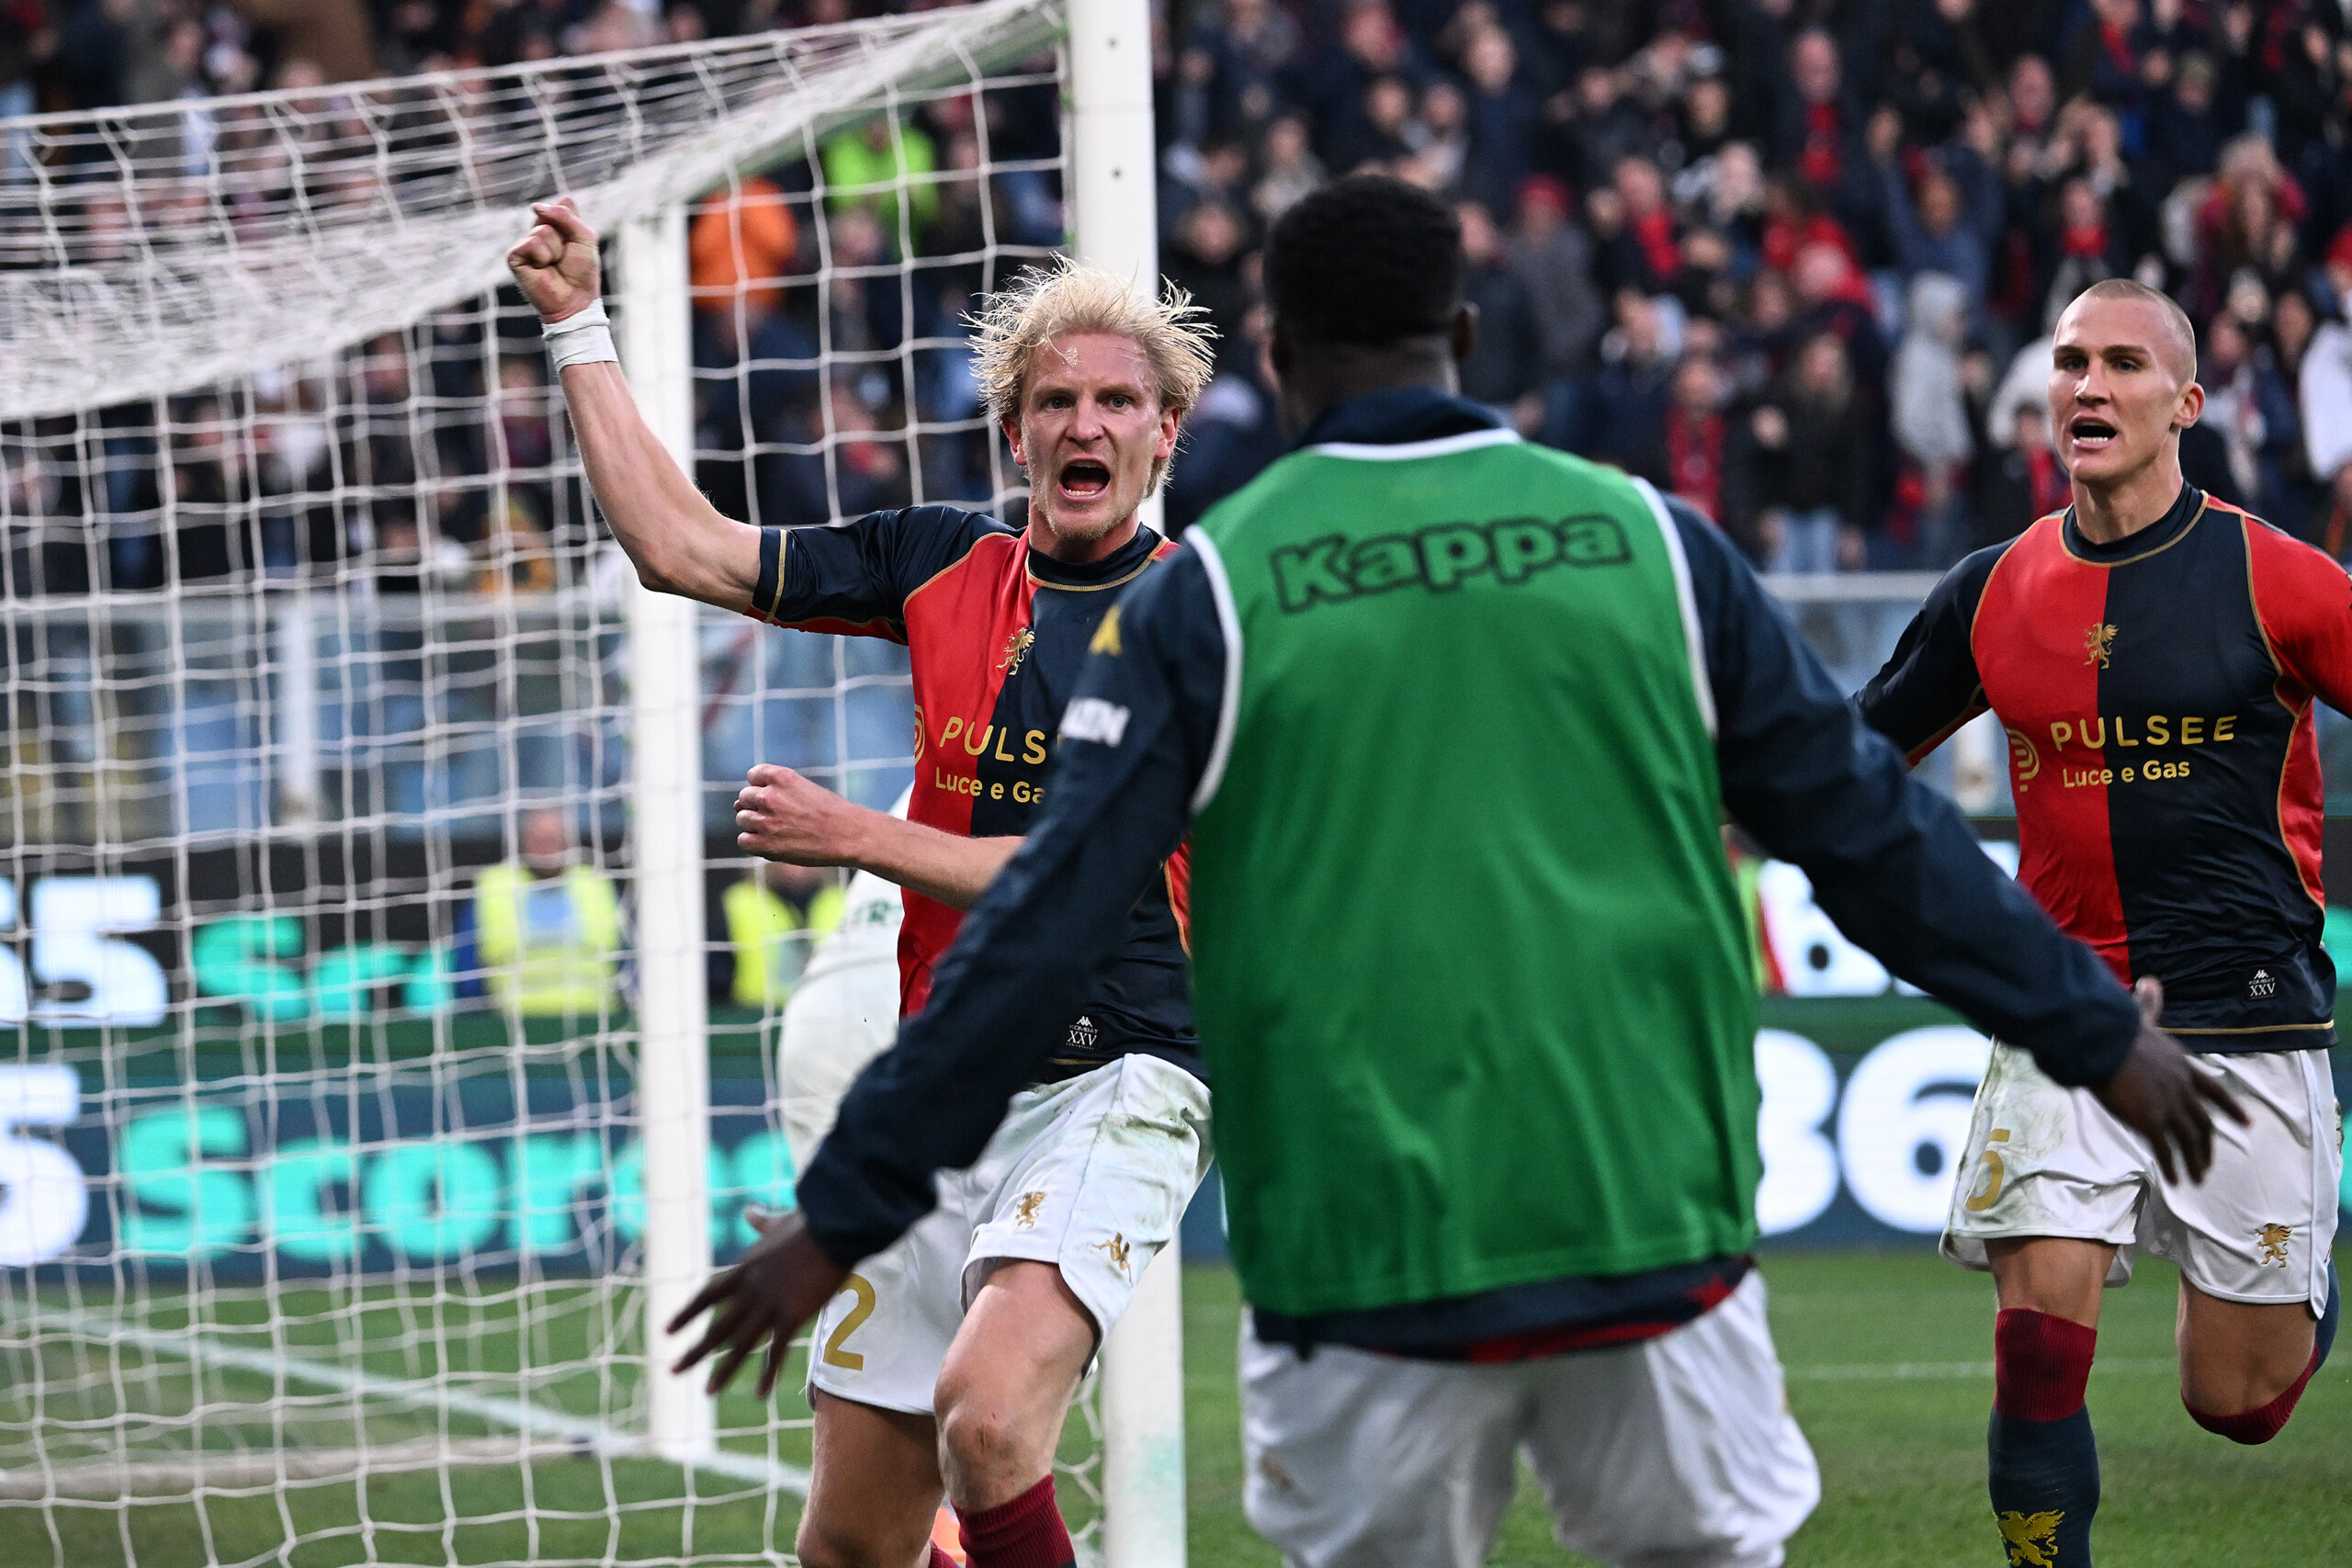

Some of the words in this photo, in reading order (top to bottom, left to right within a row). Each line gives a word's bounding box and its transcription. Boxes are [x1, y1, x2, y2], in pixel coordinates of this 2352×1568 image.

[1269, 512, 1634, 614] Kappa
[939, 716, 1064, 765] PULS
[2050, 714, 2238, 752] PULSEE
[935, 766, 983, 797] Luce
[990, 783, 1004, 800] e
[2062, 767, 2113, 788] Luce
[2120, 766, 2134, 783] e
[2143, 760, 2191, 781] Gas
[0, 874, 168, 1028] 5
[2249, 982, 2277, 997] XXV
[1067, 1030, 1097, 1046] XXV
[1964, 1128, 2011, 1213] 5
[822, 1273, 876, 1371] 2
